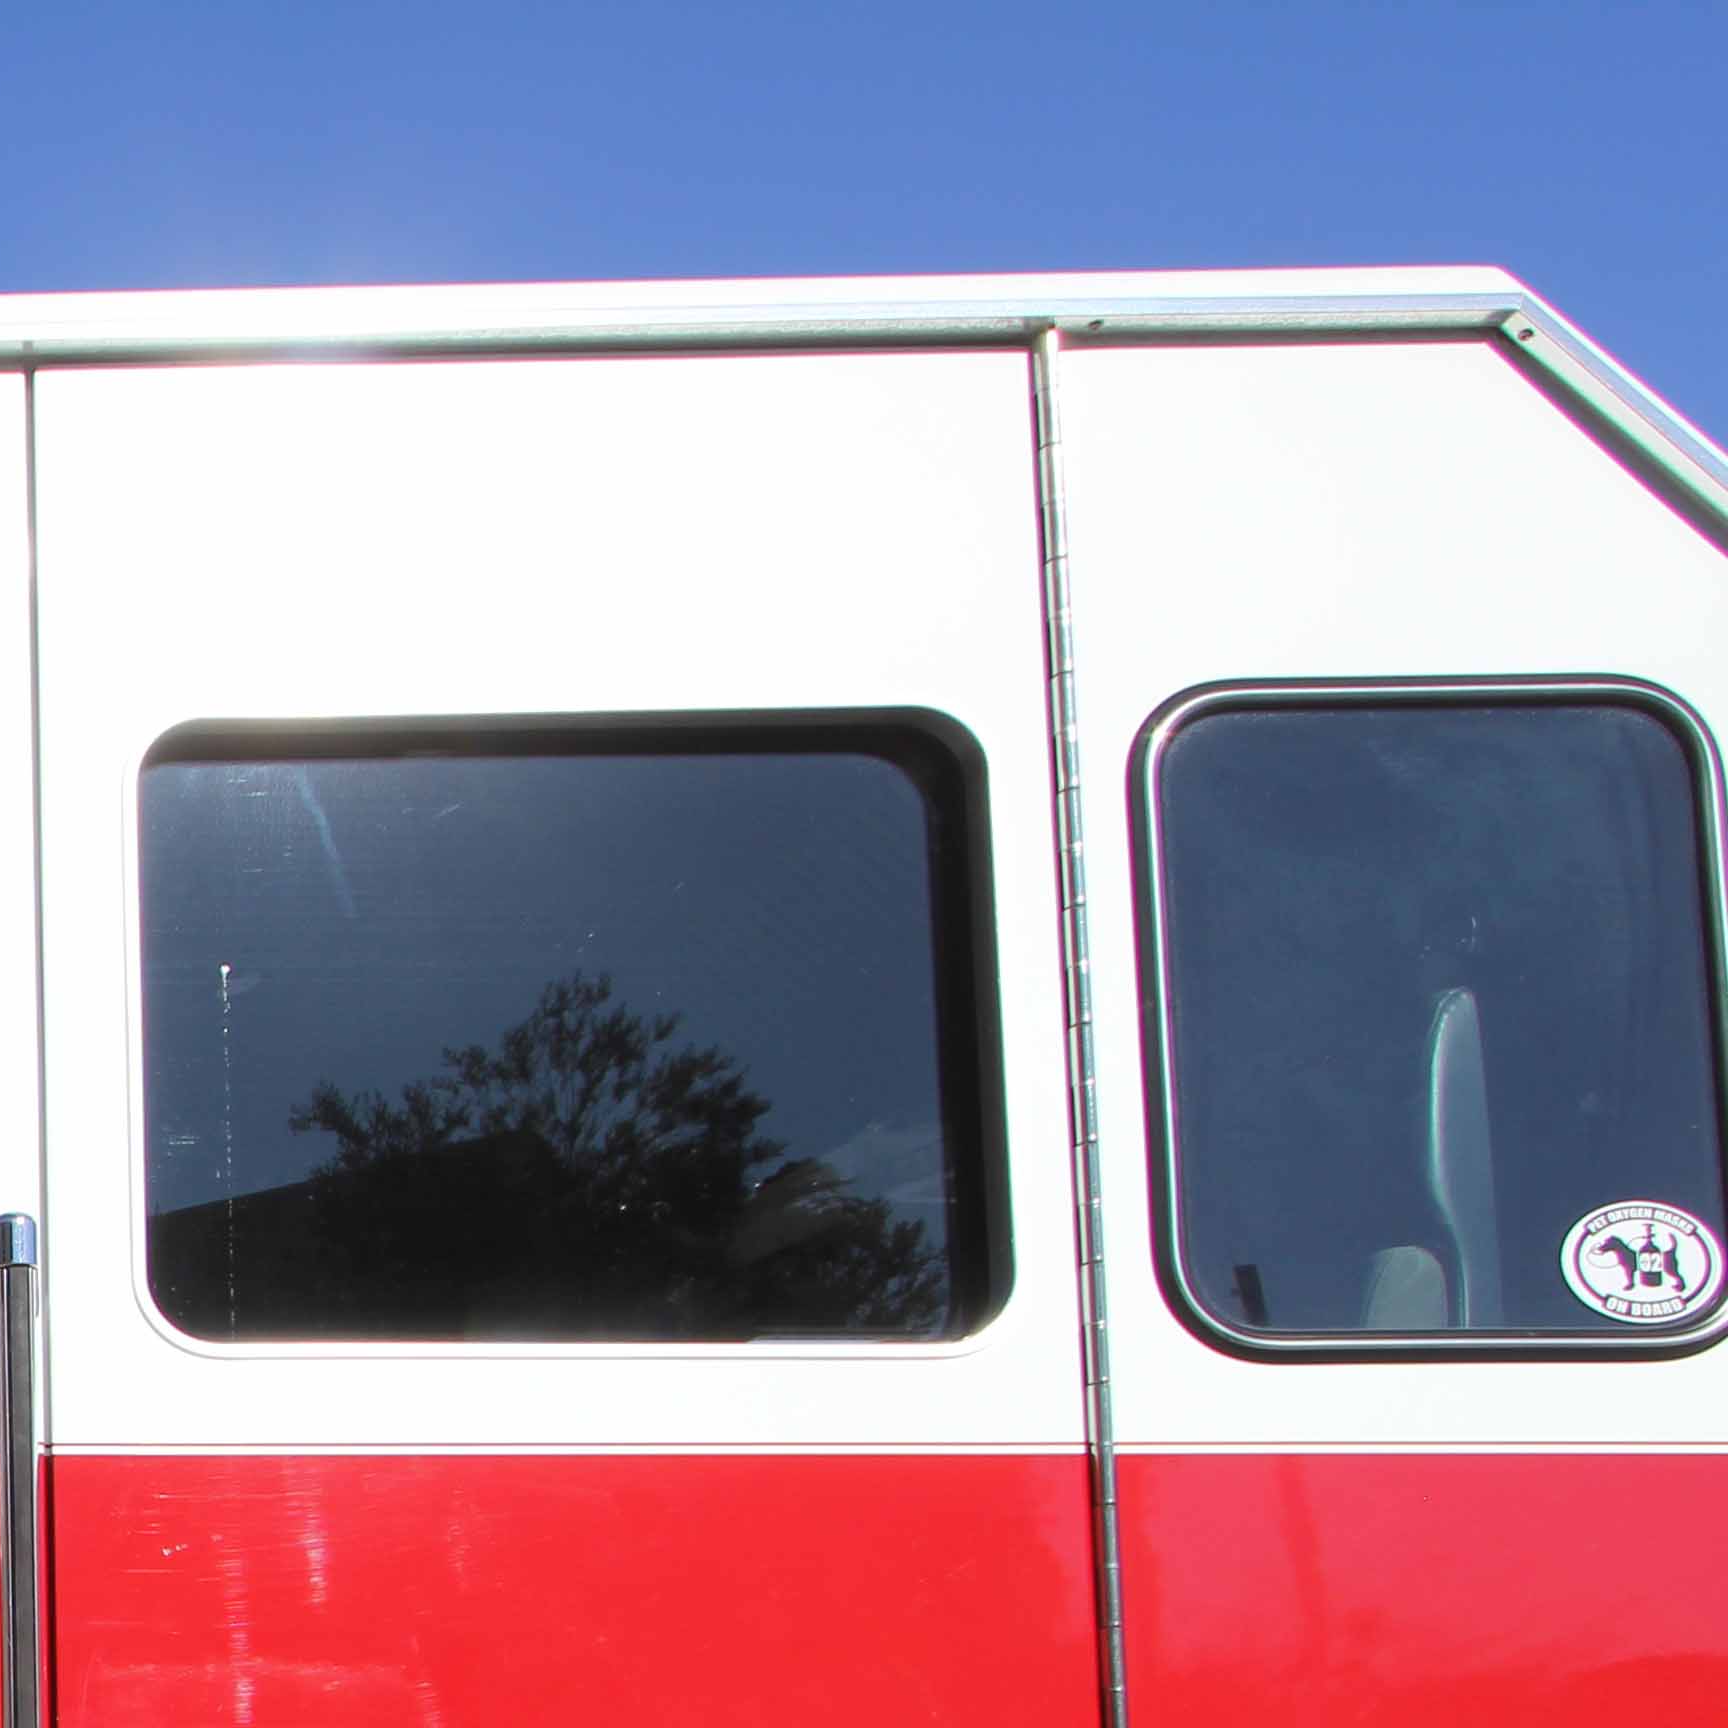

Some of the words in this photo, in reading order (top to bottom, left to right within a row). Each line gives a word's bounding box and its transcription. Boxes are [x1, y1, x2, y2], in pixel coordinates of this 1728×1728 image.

[1587, 1214, 1608, 1233] PET
[1607, 1207, 1653, 1223] OXYGEN
[1606, 1296, 1628, 1313] ON
[1631, 1298, 1682, 1317] BOARD
